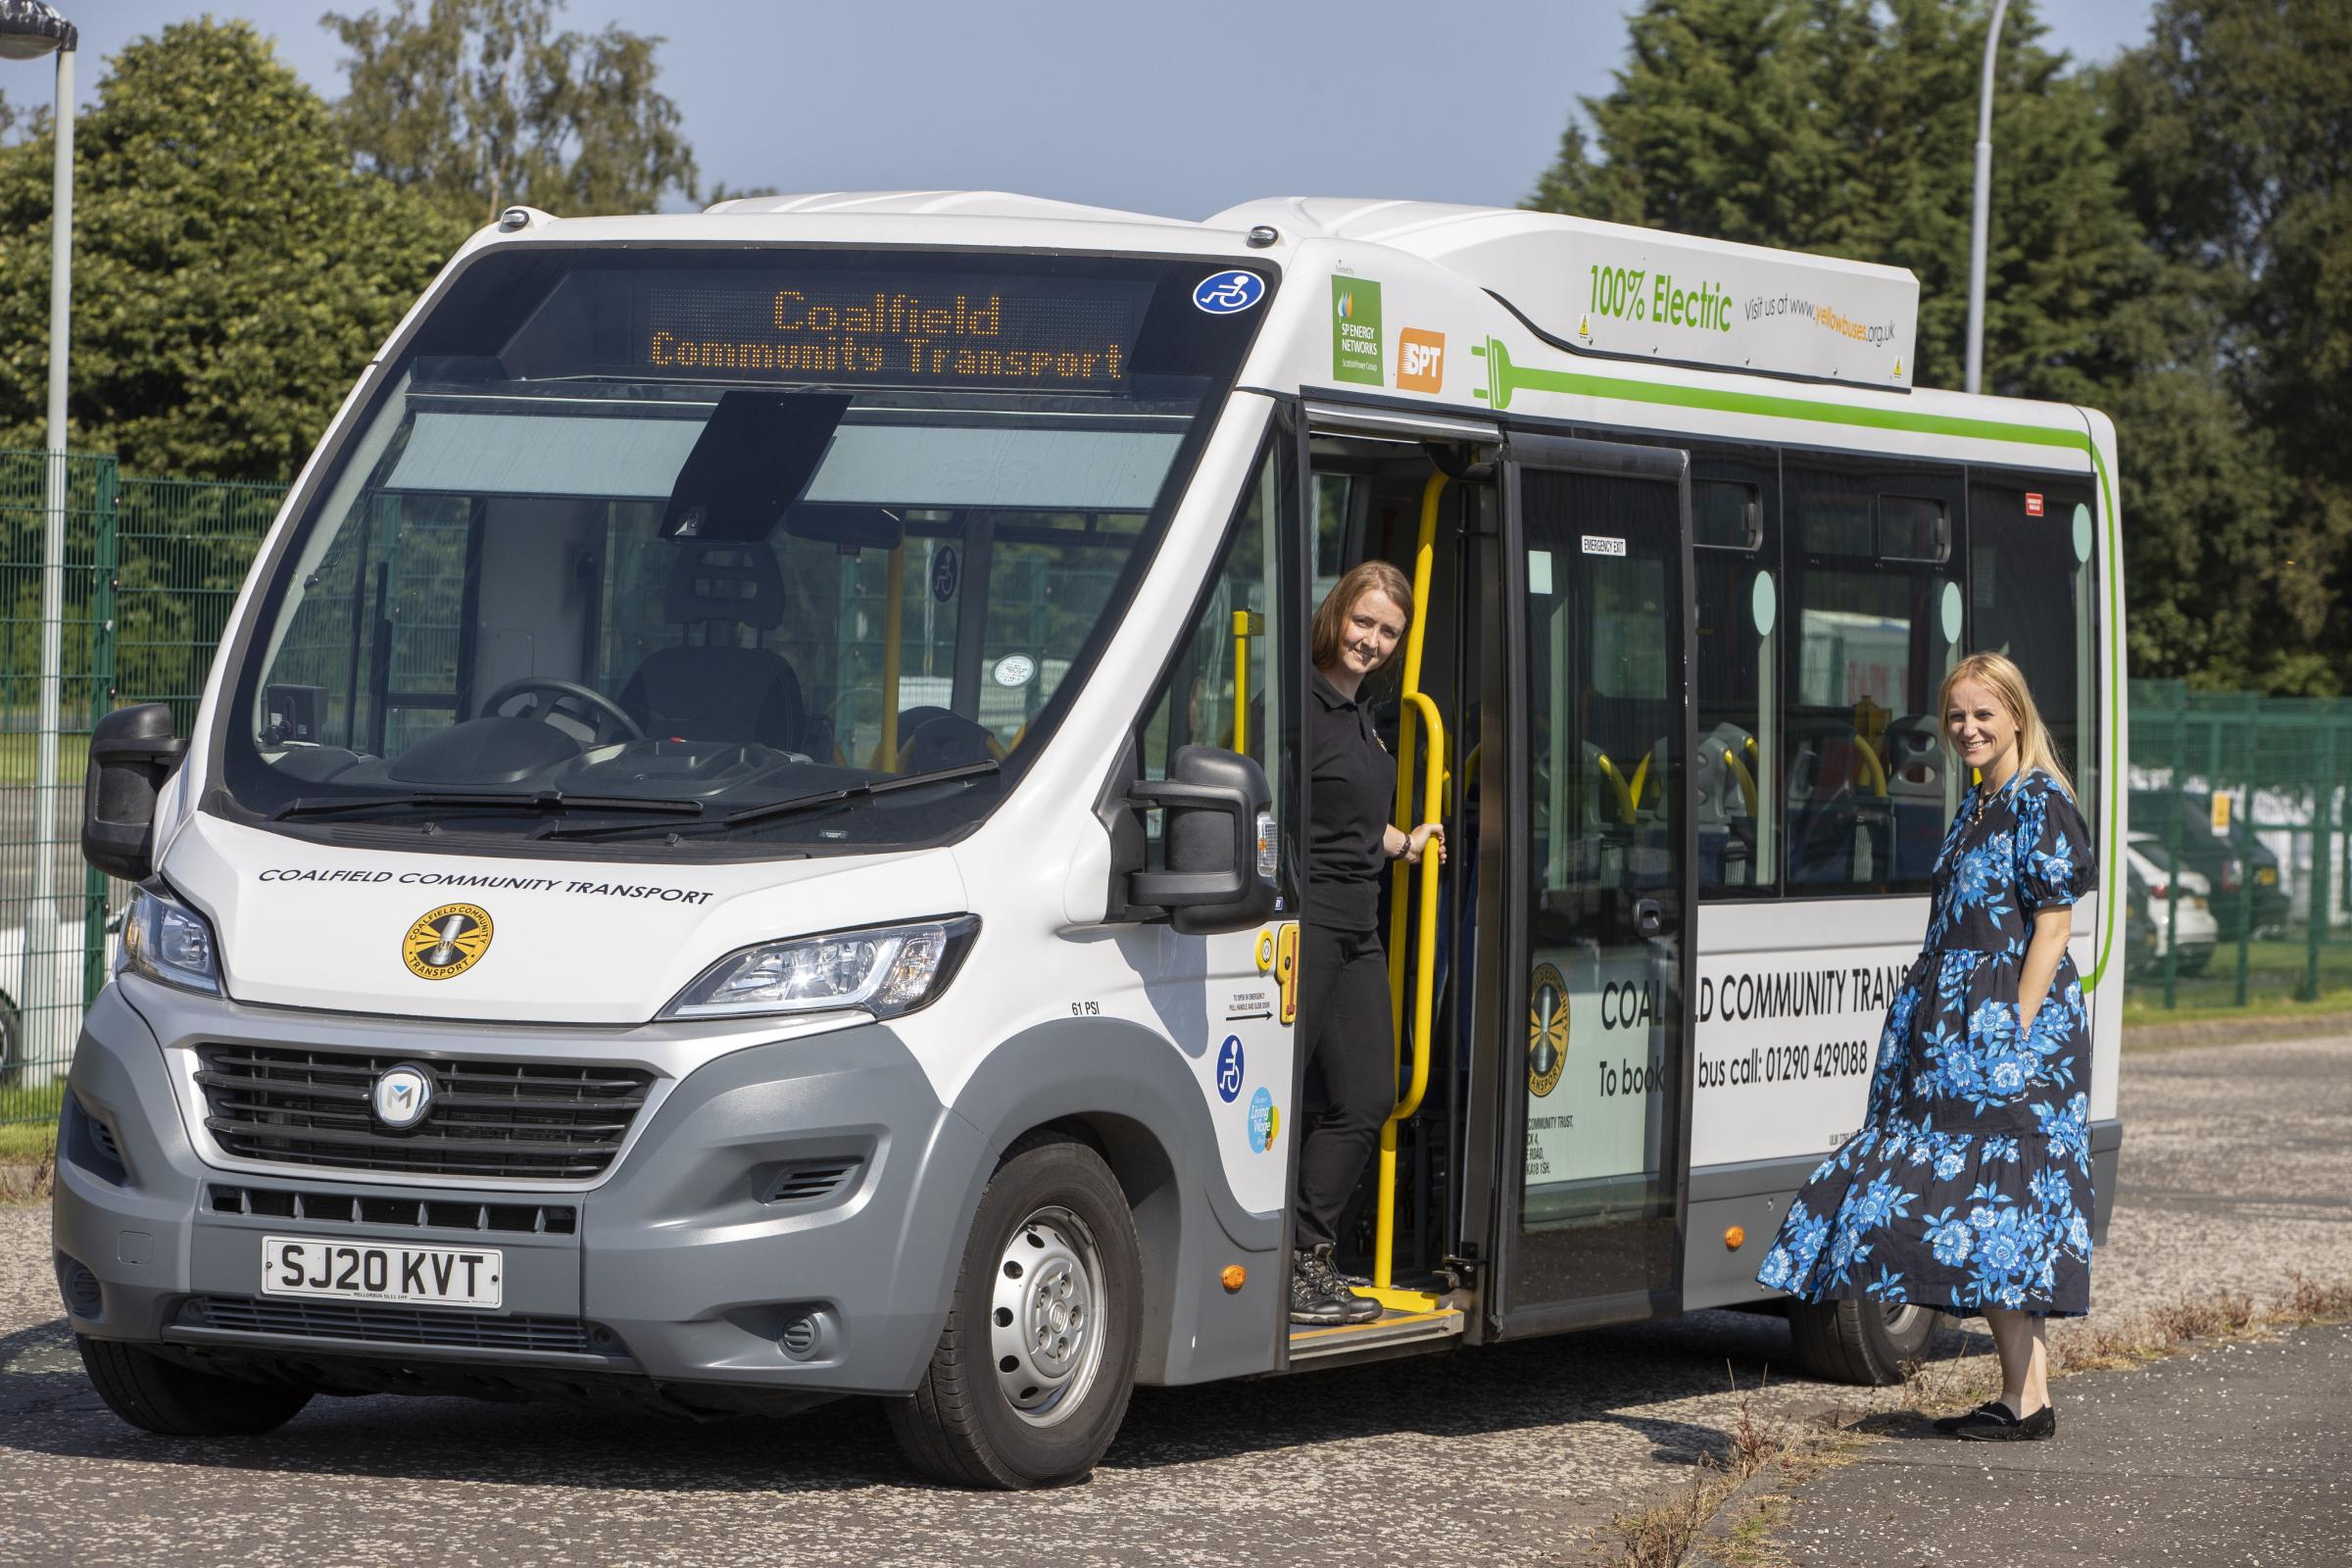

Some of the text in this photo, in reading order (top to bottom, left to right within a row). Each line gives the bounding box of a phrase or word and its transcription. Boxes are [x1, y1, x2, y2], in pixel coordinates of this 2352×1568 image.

[775, 290, 1000, 335] Coalfield
[1591, 265, 1734, 332] 100% Electric
[1342, 322, 1375, 340] SP ENERGY
[1744, 293, 1896, 348] Visit us at www.yellowbuses.org.uk
[651, 331, 1122, 379] Community Transport
[1342, 338, 1378, 356] NETWORKS
[1401, 342, 1441, 378] SPT
[1584, 538, 1624, 554] EMERGENCY EXIT
[259, 868, 714, 906] COALFIELD COMMUNITY TRANSPORT
[409, 906, 489, 944] COALFIELD COMMUNITY
[409, 956, 469, 977] TRANSPORT
[1071, 1001, 1101, 1016] 61 PSI
[1720, 969, 1846, 1022] COMMUNITY
[1599, 1040, 1867, 1097] To book bus call: 01290 429088
[1250, 1104, 1270, 1120] Living
[1557, 1114, 1574, 1129] TRUST,
[281, 1245, 484, 1298] SJ20 KVT
